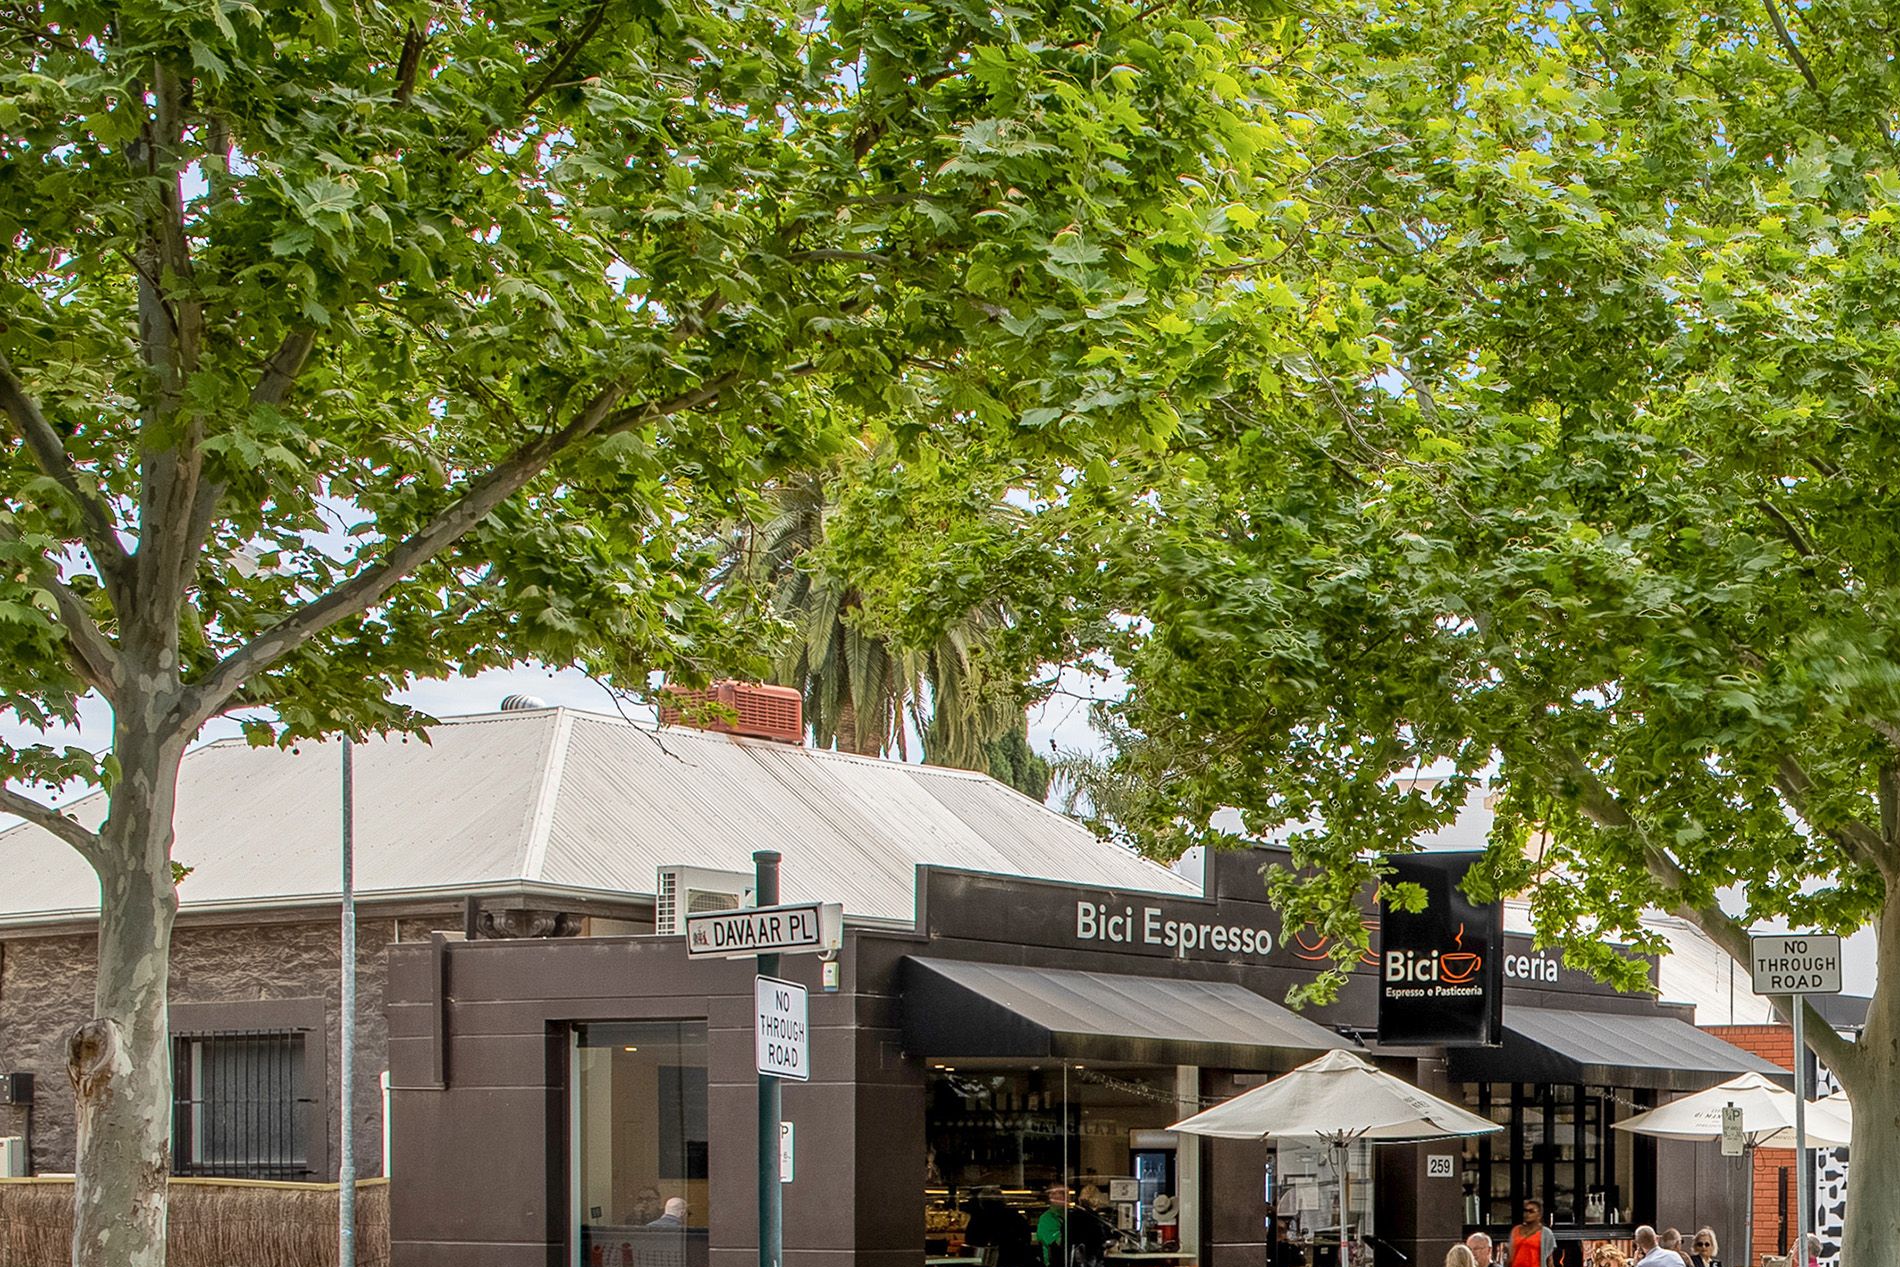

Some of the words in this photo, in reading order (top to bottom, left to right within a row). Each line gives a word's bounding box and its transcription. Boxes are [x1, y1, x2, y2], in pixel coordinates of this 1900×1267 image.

[713, 916, 782, 947] DAVAAR
[789, 914, 813, 941] PL
[1076, 901, 1133, 943] Bici
[1143, 907, 1273, 958] Espresso
[1784, 941, 1808, 954] NO
[1385, 950, 1439, 982] Bici
[1504, 951, 1558, 982] ceria
[1758, 957, 1836, 972] THROUGH
[1385, 987, 1425, 999] Espresso
[1427, 988, 1434, 997] e
[1435, 985, 1483, 997] Pasticceria
[1771, 975, 1823, 989] ROAD
[775, 990, 790, 1013] NO
[760, 1014, 805, 1043] THROUGH
[768, 1044, 798, 1068] ROAD
[1430, 1159, 1451, 1174] 259
